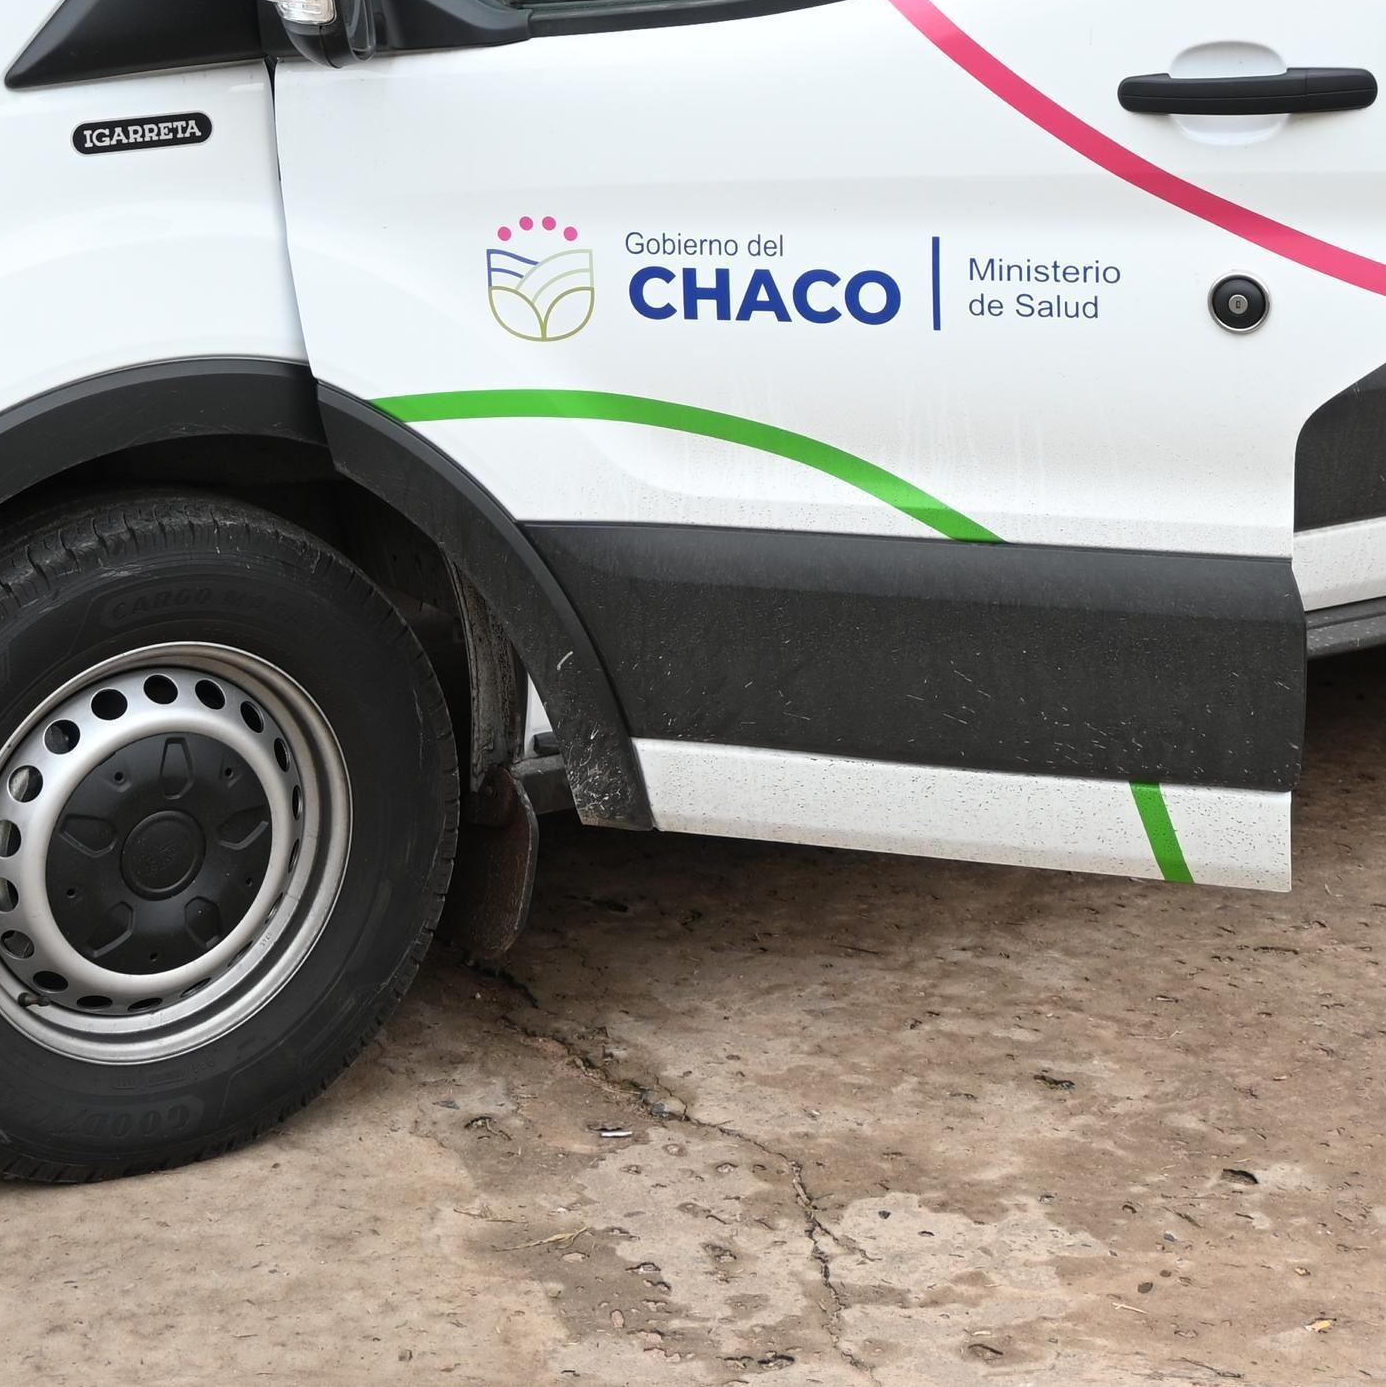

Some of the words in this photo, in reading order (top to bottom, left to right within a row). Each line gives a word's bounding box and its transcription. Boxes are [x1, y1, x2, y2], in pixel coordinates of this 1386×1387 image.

[83, 119, 202, 148] IGARRETA
[625, 231, 739, 257] Gobierno
[747, 233, 784, 257] del
[969, 257, 1121, 285] Ministerio
[628, 265, 902, 326] CHACO
[968, 293, 1004, 318] de
[1015, 293, 1099, 319] Salud
